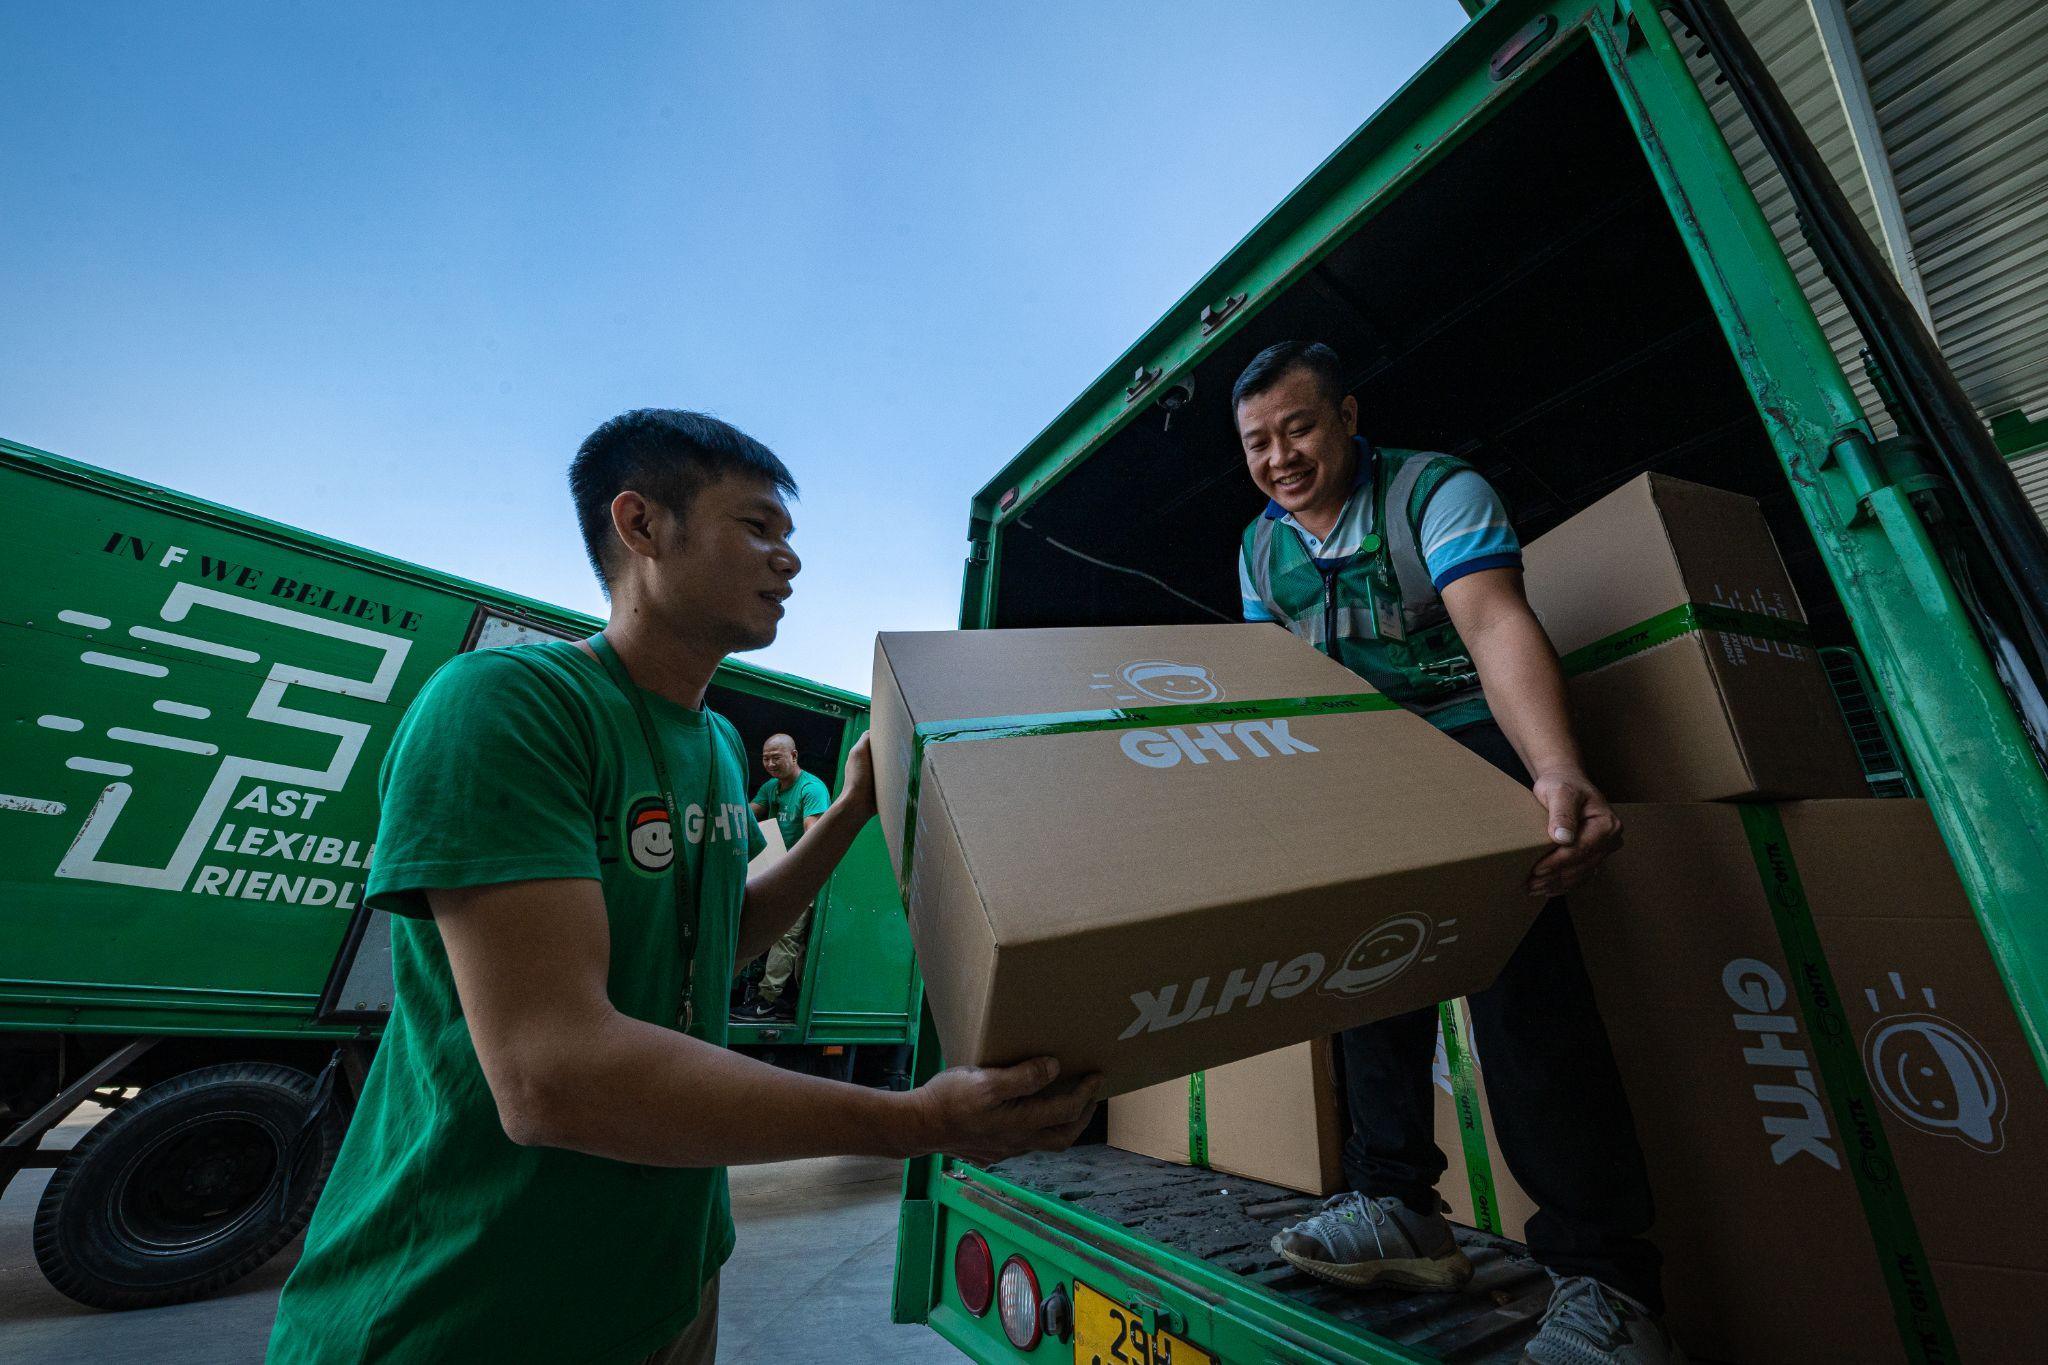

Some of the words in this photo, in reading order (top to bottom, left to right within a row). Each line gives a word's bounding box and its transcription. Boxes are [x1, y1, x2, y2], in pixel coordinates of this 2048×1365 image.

[102, 532, 154, 562] IN
[160, 546, 188, 568] F
[200, 555, 264, 591] WE
[269, 575, 423, 632] BELIEVE
[1120, 719, 1319, 768] GHTK
[234, 785, 326, 820] AST
[685, 803, 748, 844] GHT
[191, 866, 366, 910] RIENDL
[1117, 951, 1325, 1041] GHTK
[1722, 958, 1841, 1170] GHTK
